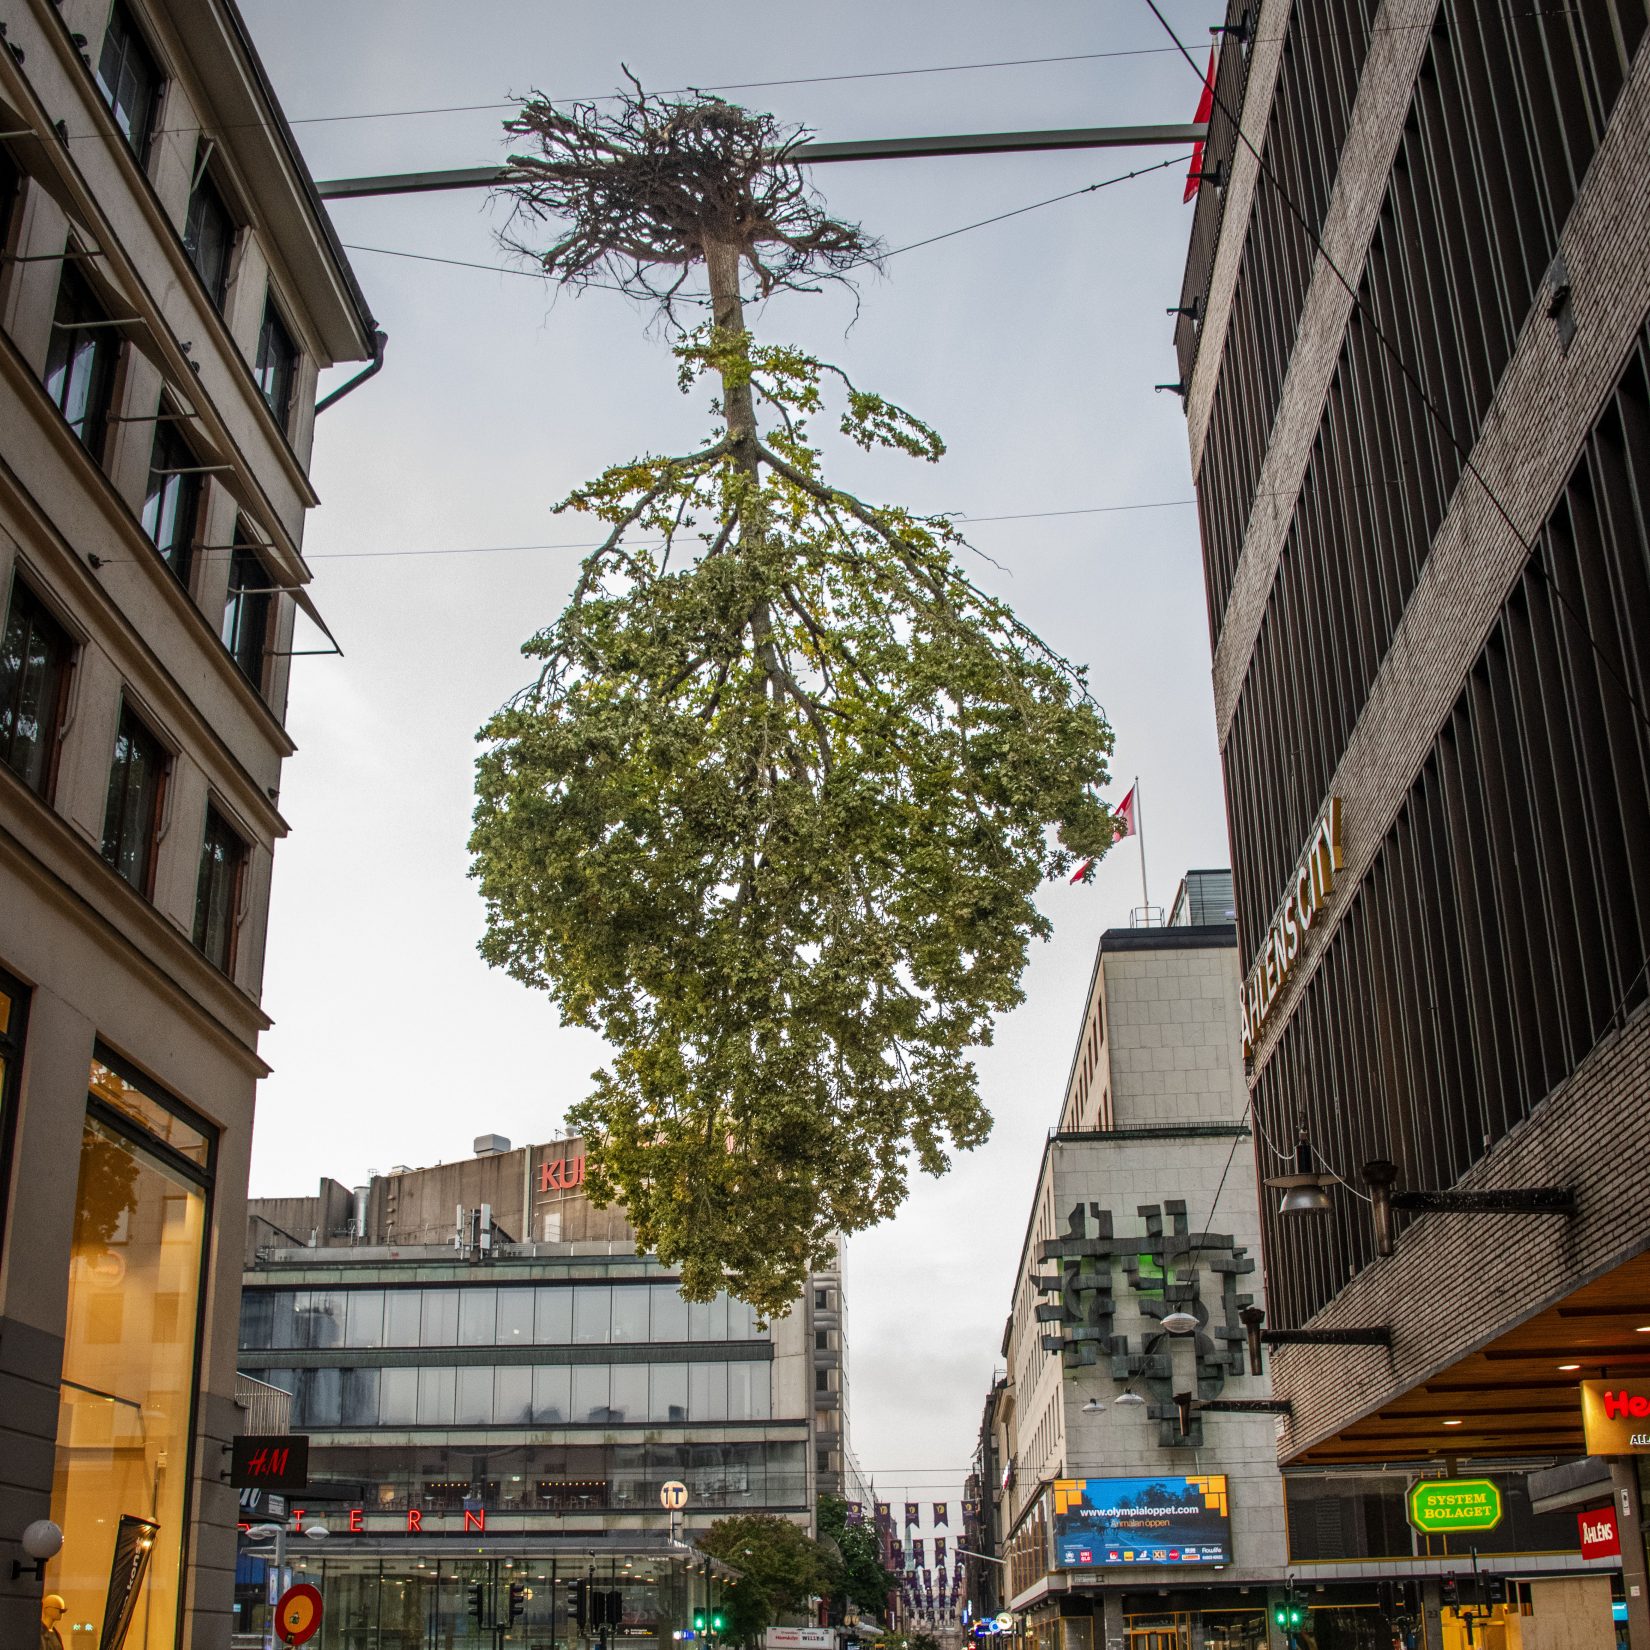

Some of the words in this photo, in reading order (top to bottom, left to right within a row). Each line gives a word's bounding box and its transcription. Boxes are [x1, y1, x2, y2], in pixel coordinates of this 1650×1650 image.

[1297, 797, 1342, 930] CITY
[1630, 1434, 1650, 1446] ALL
[248, 1448, 289, 1476] H&M
[1427, 1493, 1486, 1506] SYSTEM
[1080, 1506, 1199, 1518] www.olympialoppet.com
[1424, 1506, 1492, 1518] BOLAGET
[236, 1509, 485, 1532] TERN
[1145, 1518, 1170, 1528] öppen
[1583, 1521, 1613, 1544] ÅHLÉNS
